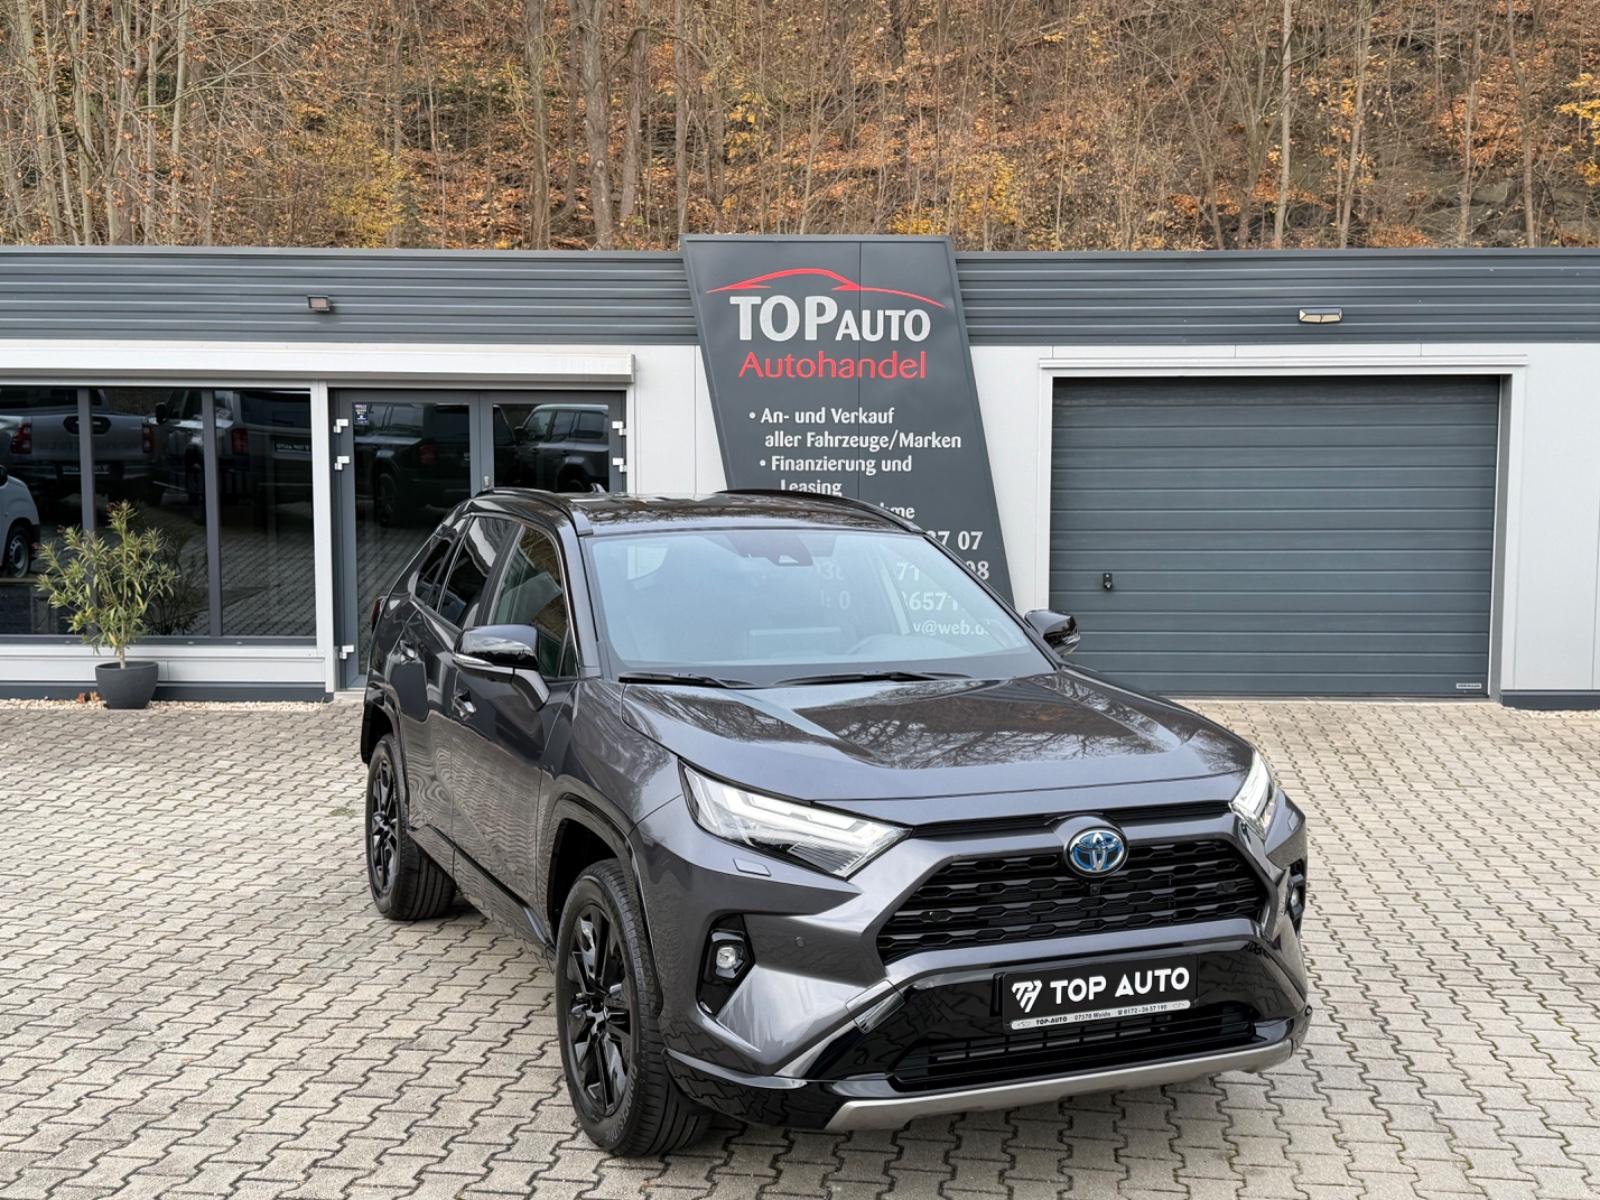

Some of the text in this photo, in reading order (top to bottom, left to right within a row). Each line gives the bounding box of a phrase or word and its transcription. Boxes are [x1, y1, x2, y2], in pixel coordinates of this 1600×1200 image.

[738, 351, 926, 379] Autohandel
[760, 407, 895, 424] An- und Verkauf
[765, 429, 962, 453] aller Fahrzeuge/Marken
[771, 455, 912, 476] Finanzierung und
[957, 530, 983, 550] 07
[1050, 967, 1190, 1004] TOP AUTO
[1036, 1016, 1068, 1025] TOP-AUTO
